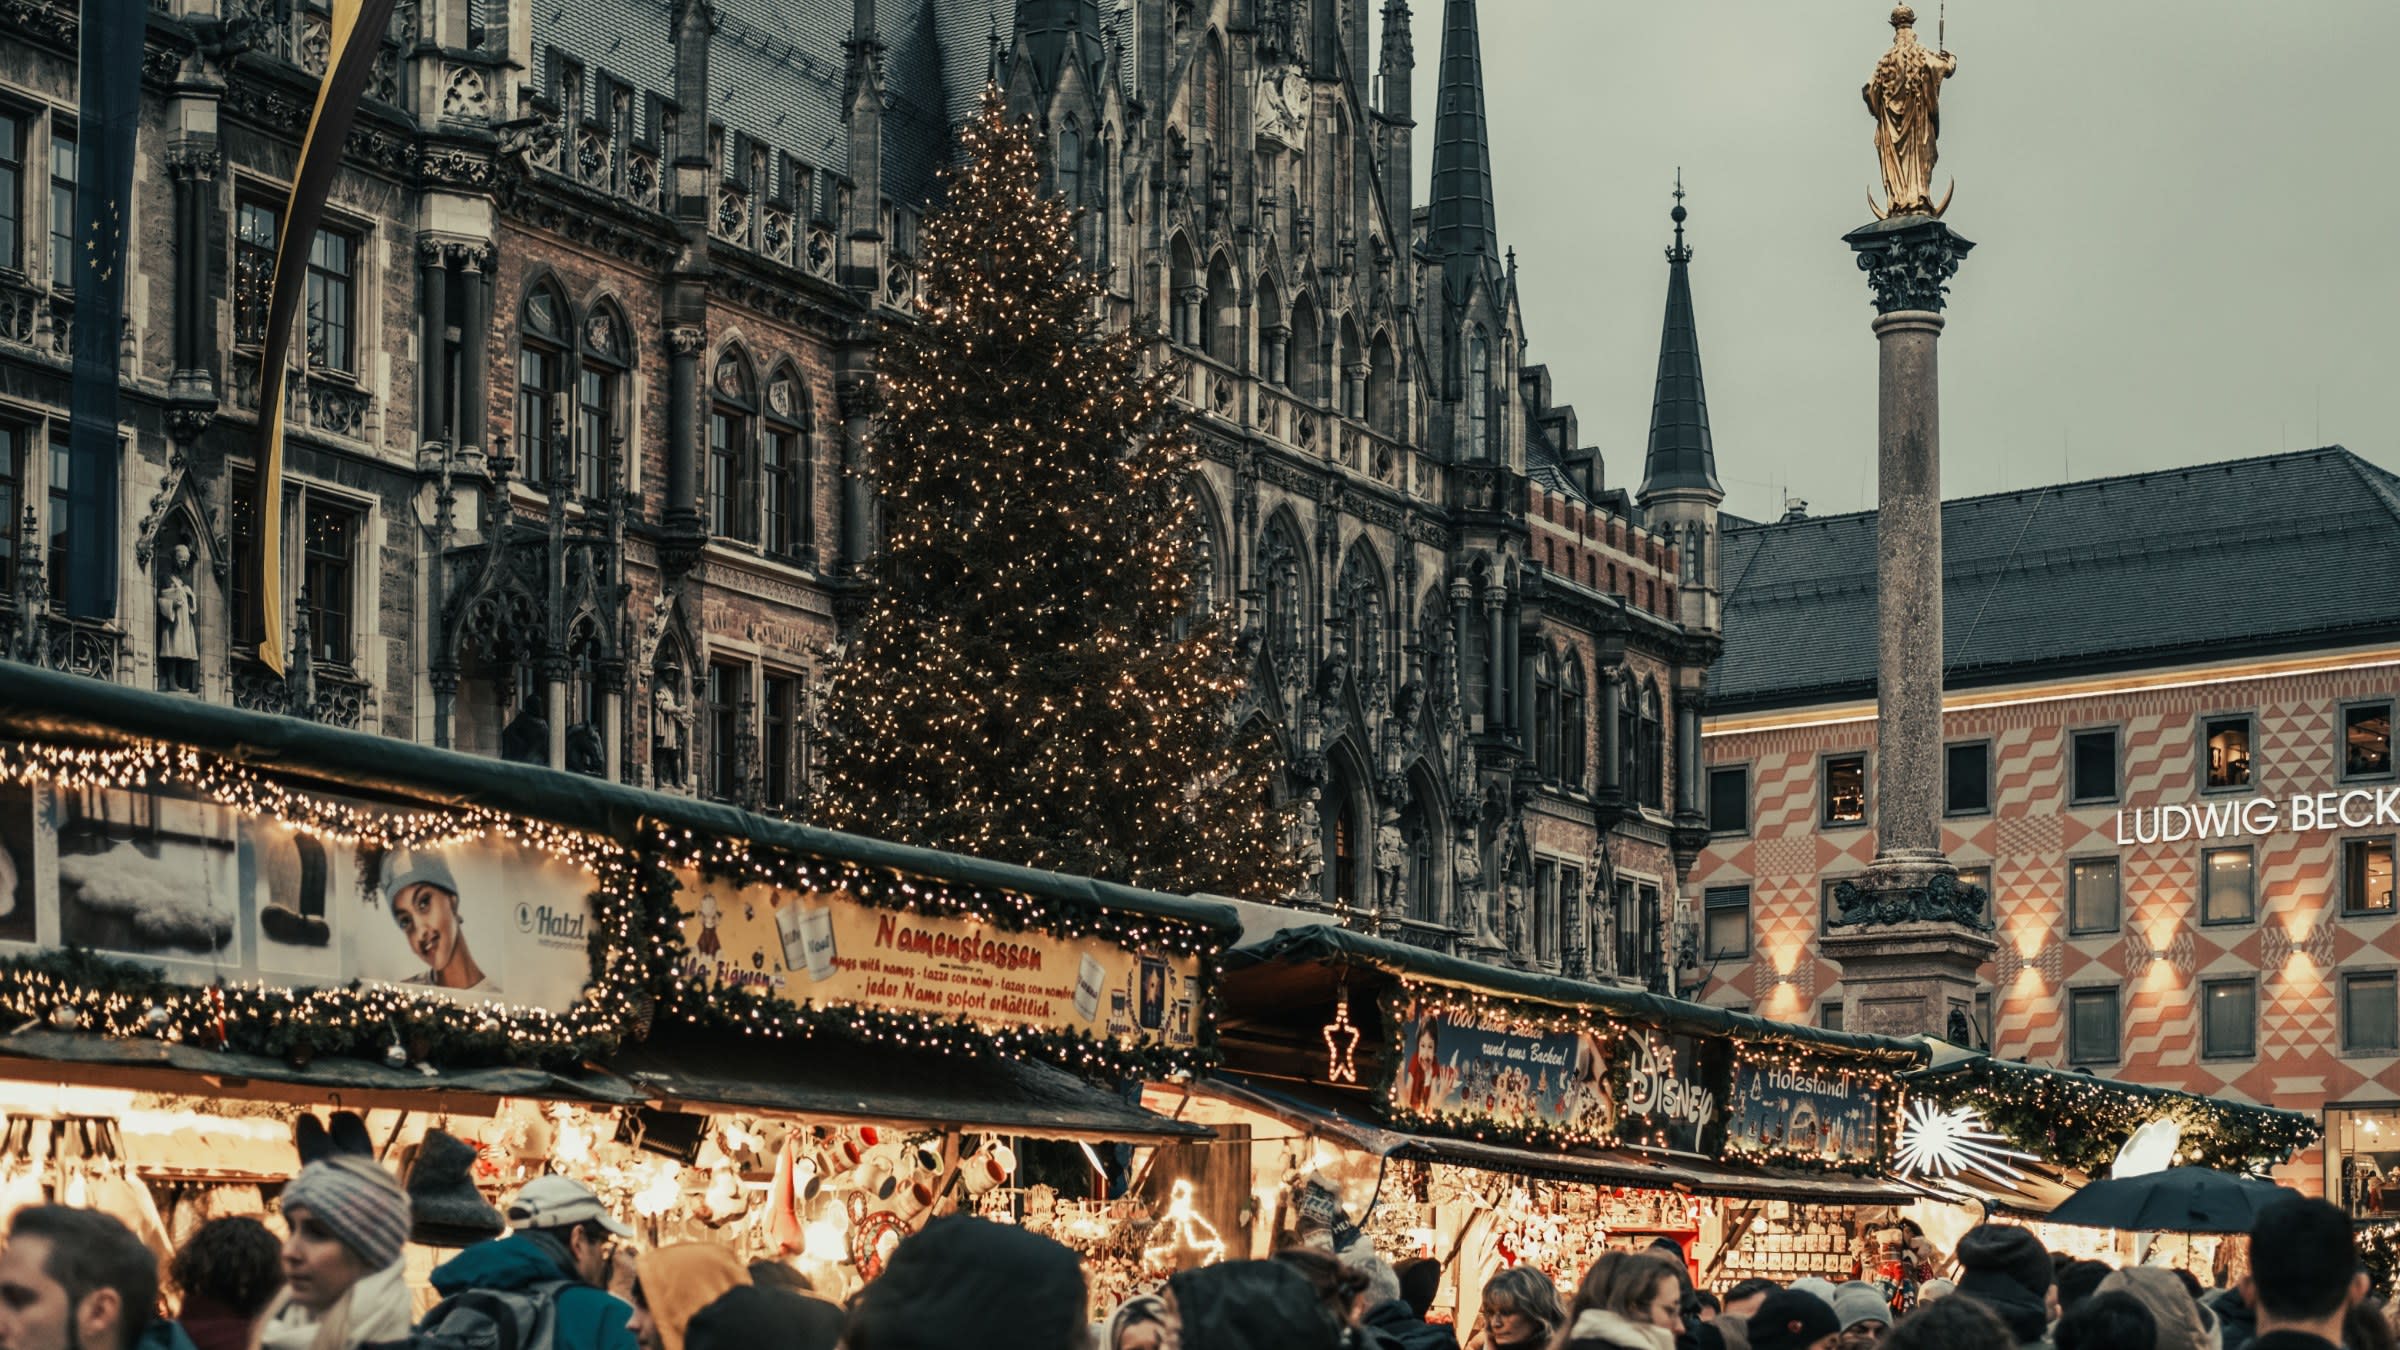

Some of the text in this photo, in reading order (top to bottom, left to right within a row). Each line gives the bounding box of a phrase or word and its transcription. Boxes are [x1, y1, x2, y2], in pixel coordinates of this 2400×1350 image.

[2117, 788, 2400, 845] LUDWIG BECK
[536, 904, 585, 940] Hatzl
[874, 913, 1042, 972] Namenstassen
[829, 955, 857, 972] mugs
[859, 957, 880, 973] with
[883, 963, 915, 979] names
[923, 965, 949, 982] tazze
[951, 972, 968, 985] con
[970, 975, 993, 990] nomi
[1001, 976, 1026, 995] tazas
[1027, 983, 1043, 996] con
[865, 975, 1050, 1018] jeder Name sofort erhältlich
[1481, 1039, 1569, 1067] rund ums Backen!
[1768, 1066, 1849, 1100] Holzstandl
